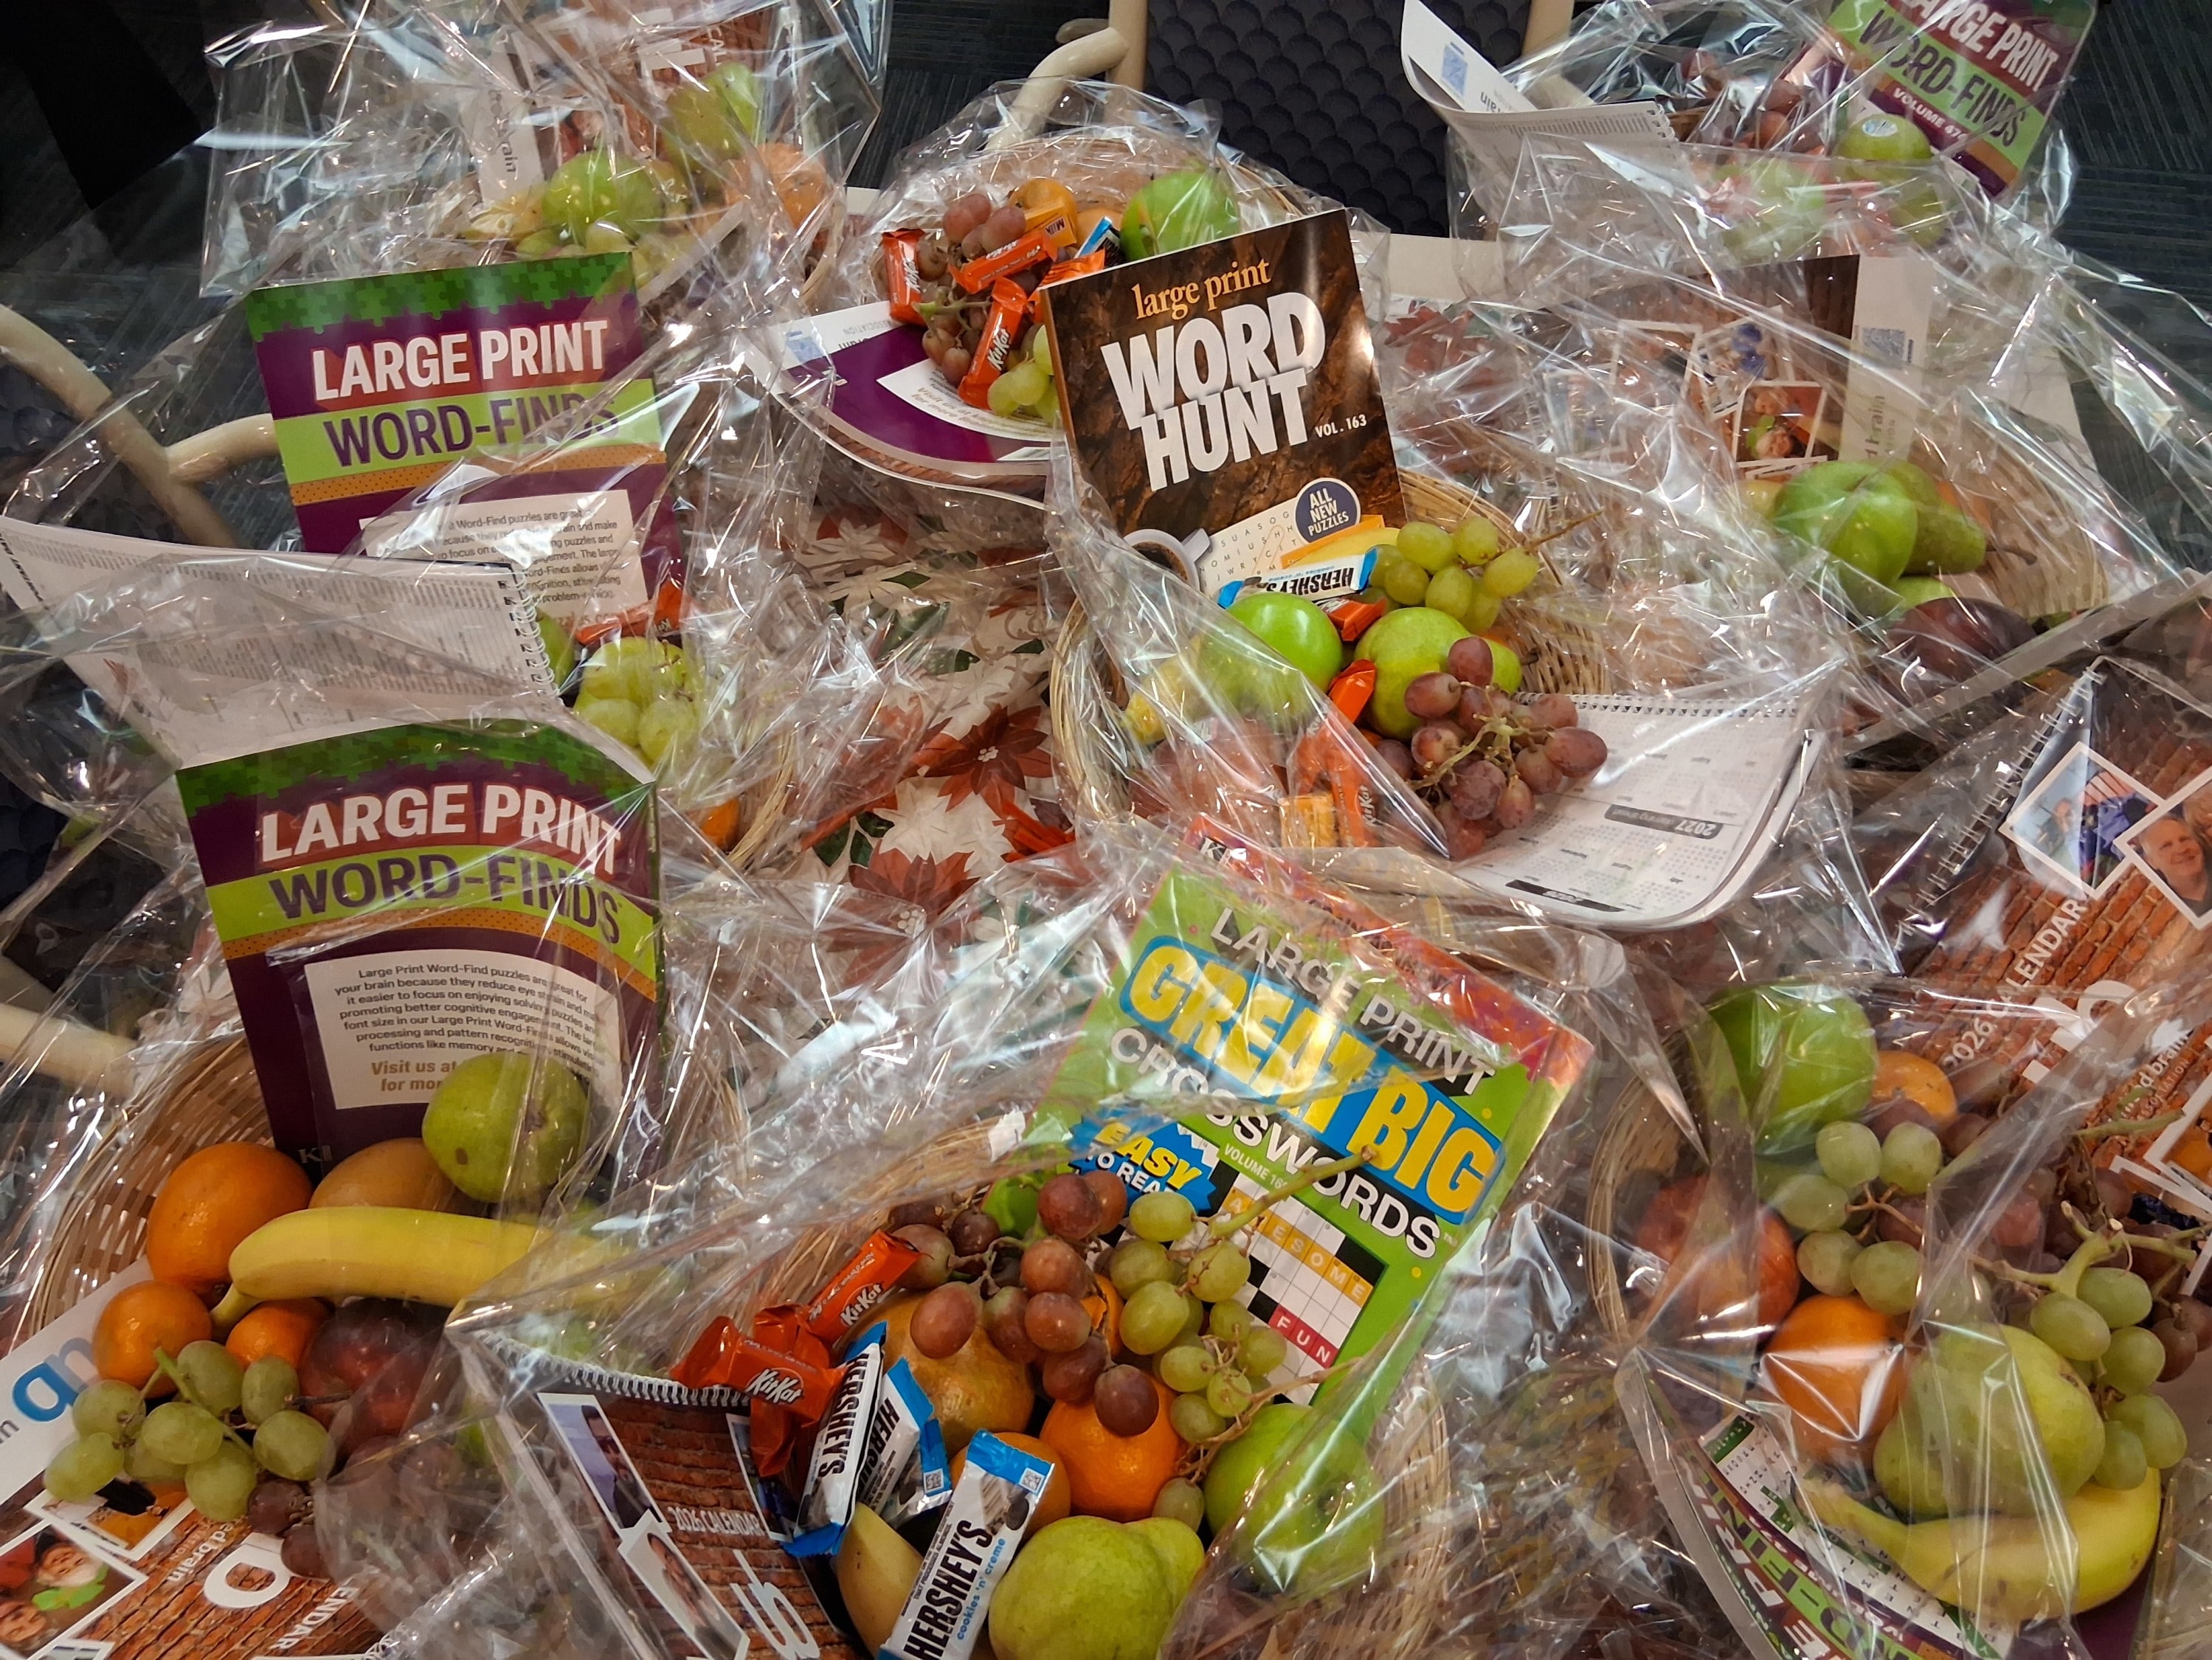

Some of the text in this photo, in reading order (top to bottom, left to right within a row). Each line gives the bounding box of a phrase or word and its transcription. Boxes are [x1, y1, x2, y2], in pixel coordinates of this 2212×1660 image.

[1986, 23, 2059, 93] PRINT
[1859, 9, 2026, 148] WORD-FINDS
[1893, 87, 1946, 130] VOLUME
[1045, 216, 1066, 236] Milk
[1131, 257, 1272, 320] large print
[312, 319, 609, 401] LARGE PRINT
[987, 328, 1011, 372] KitKat
[1100, 291, 1326, 431] WORD
[323, 391, 620, 468] WORD-FINDS
[1141, 367, 1309, 492] HUNT
[1346, 413, 1367, 432] 163
[1309, 487, 1333, 510] ALL
[1309, 499, 1338, 524] NEW
[455, 514, 508, 530] Word-Find
[508, 512, 542, 525] puzzles
[543, 512, 558, 520] are
[594, 519, 618, 530] make
[1307, 511, 1349, 537] PUZZLES
[449, 533, 614, 559] focus on puzzles and
[580, 548, 598, 558] The
[261, 784, 622, 875] LARGE PRINT
[1673, 818, 1717, 837] 2027
[269, 853, 623, 945] WORD-FINDS
[334, 983, 362, 996] your
[364, 979, 395, 991] brain
[397, 977, 448, 988] because
[449, 977, 476, 989] they
[477, 978, 516, 992] reduce
[517, 986, 536, 997] eye
[359, 967, 393, 978] Large
[395, 964, 425, 975] Print
[426, 964, 488, 975] Word-Find
[490, 967, 531, 984] puzzles
[532, 975, 548, 987] are
[339, 1004, 403, 1020] promoting
[404, 1003, 442, 1012] better
[443, 1003, 497, 1015] cognitive
[347, 997, 356, 1005] it
[358, 992, 395, 1004] easier
[397, 992, 411, 1000] to
[412, 990, 446, 999] focus
[464, 992, 511, 1006] enjoying
[1211, 907, 1362, 1014] LARGE
[1360, 995, 1496, 1096] PRINT
[343, 1019, 370, 1031] font
[370, 1017, 395, 1027] size
[396, 1016, 408, 1025] in
[409, 1016, 429, 1024] our
[431, 1015, 464, 1026] Large
[466, 1015, 493, 1027] Print
[356, 1027, 490, 1042] processing and pattern
[369, 1040, 425, 1052] functions
[426, 1040, 446, 1049] like
[448, 1041, 494, 1054] memory
[371, 1059, 410, 1076] Visit
[415, 1061, 436, 1073] us
[380, 1078, 444, 1093] for mor
[1130, 945, 1499, 1216] GREAT BIG
[1086, 1143, 1115, 1170] TO
[1095, 1121, 1202, 1189] EASY
[1110, 1028, 1441, 1259] CROSSWORDS
[1223, 1142, 1269, 1181] VOLUME
[839, 1283, 883, 1327] KitKat
[1276, 1315, 1333, 1367] FUN
[743, 1368, 804, 1404] KitKat
[818, 1352, 871, 1478] HERSHEY'S
[667, 1506, 767, 1537] 2026 CALENDAR
[167, 1540, 216, 1582] brain
[902, 1519, 994, 1660] HERSHEY'S
[955, 1594, 981, 1641] cookies
[984, 1538, 1006, 1576] creme
